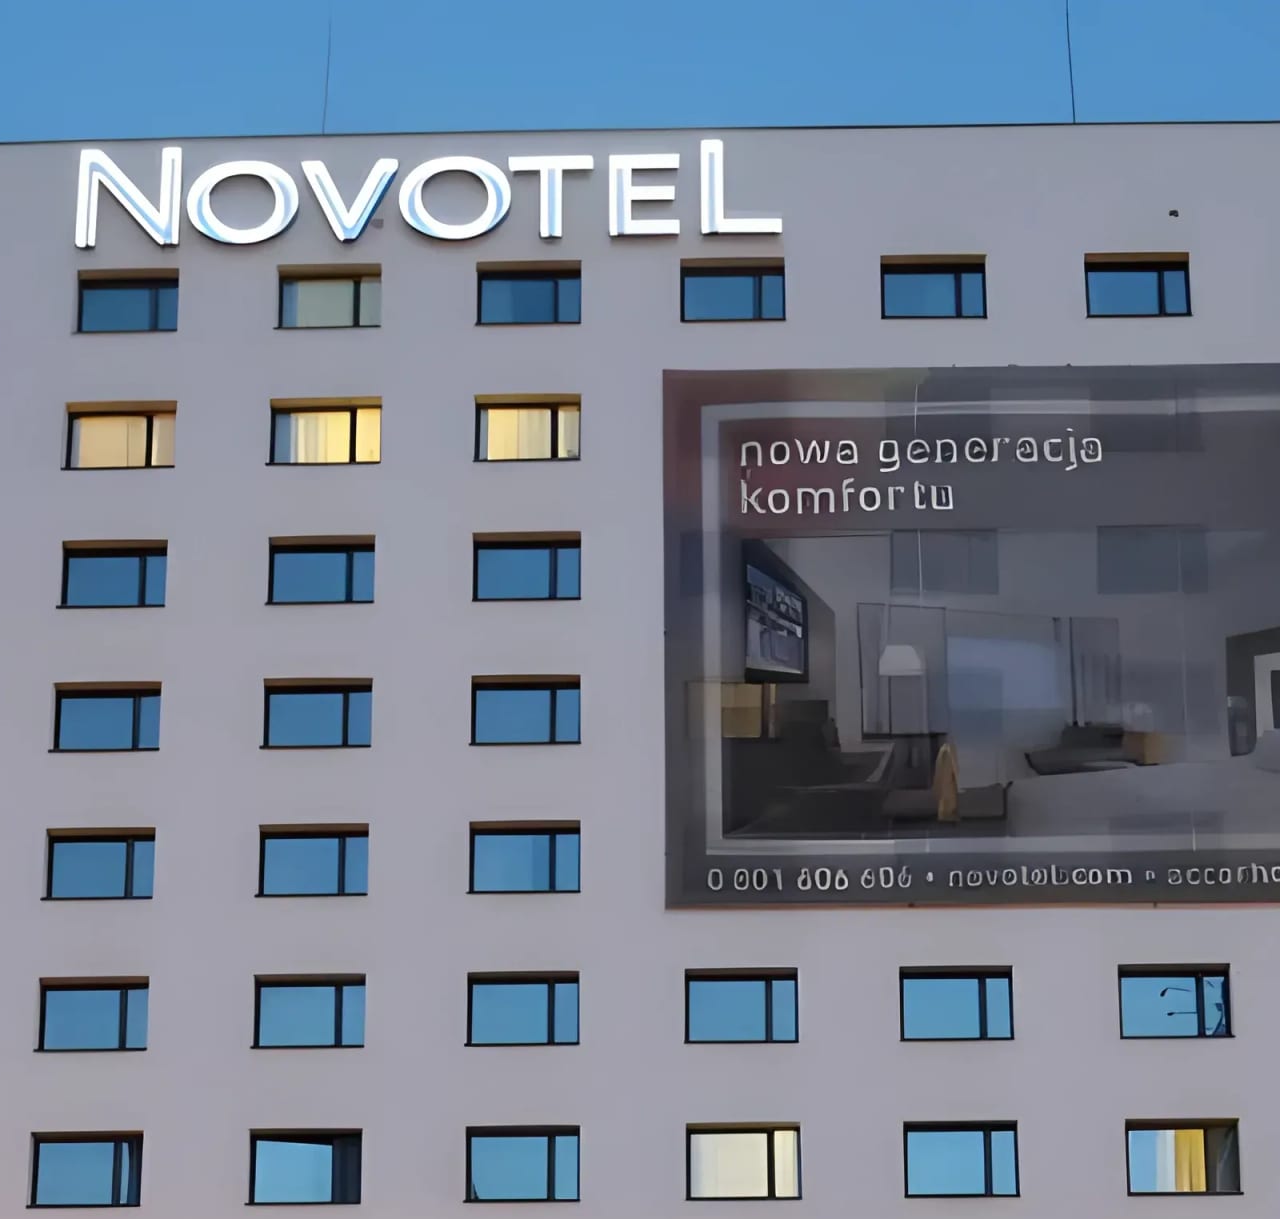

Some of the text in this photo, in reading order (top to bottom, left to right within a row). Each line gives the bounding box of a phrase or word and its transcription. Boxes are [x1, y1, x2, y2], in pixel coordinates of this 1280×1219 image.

[74, 139, 783, 248] NOVOTEL
[740, 428, 1103, 472] nowa generacja
[740, 478, 954, 514] komfortu
